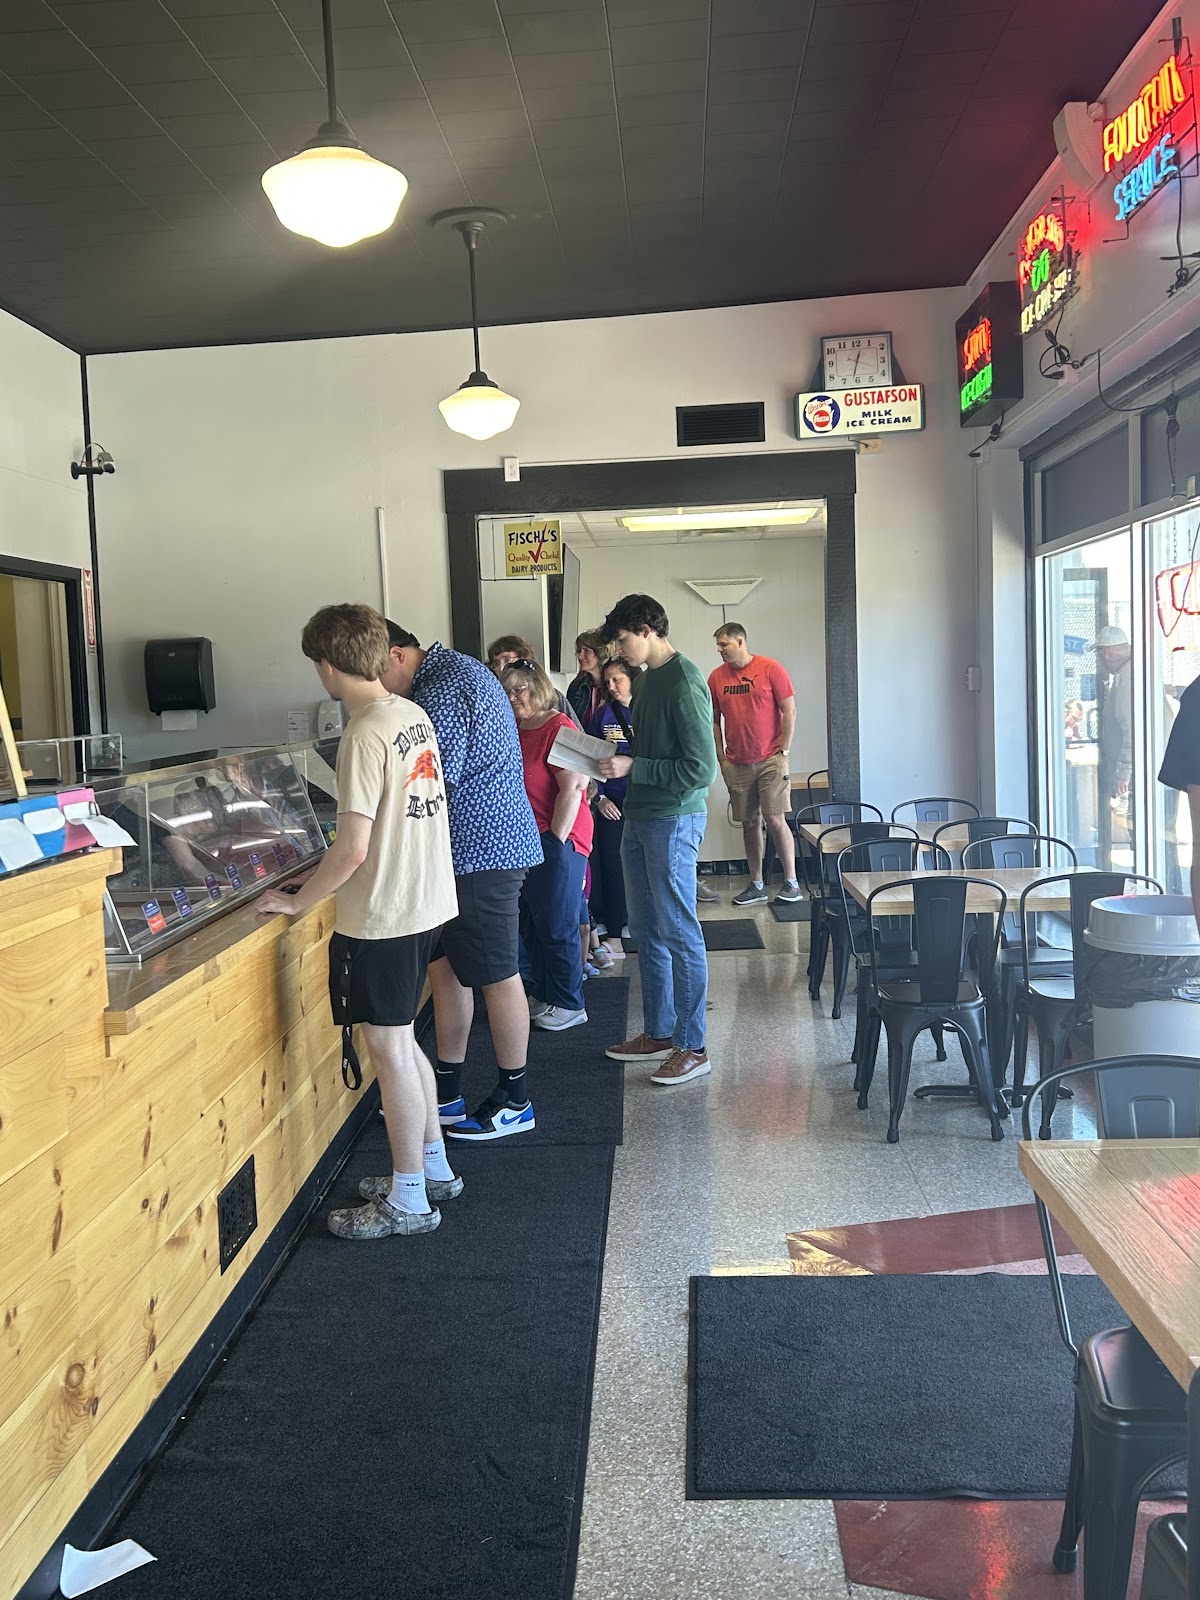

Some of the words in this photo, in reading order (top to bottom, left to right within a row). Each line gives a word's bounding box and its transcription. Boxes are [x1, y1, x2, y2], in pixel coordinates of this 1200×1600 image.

[1113, 132, 1179, 221] SERVICE
[838, 341, 847, 349] 11
[851, 340, 861, 348] 12
[867, 339, 871, 347] 1
[826, 347, 836, 355] 10
[828, 360, 834, 368] 9
[880, 356, 886, 364] 3
[880, 369, 886, 377] 4
[844, 388, 917, 406] GUSTAFSON
[861, 409, 893, 418] MILK
[870, 416, 912, 425] CREAM
[508, 530, 557, 545] FISCHL'S
[508, 552, 530, 562] Quality
[512, 565, 528, 573] DAIRY
[530, 563, 558, 573] PRODUCTS
[723, 683, 750, 695] PUMA
